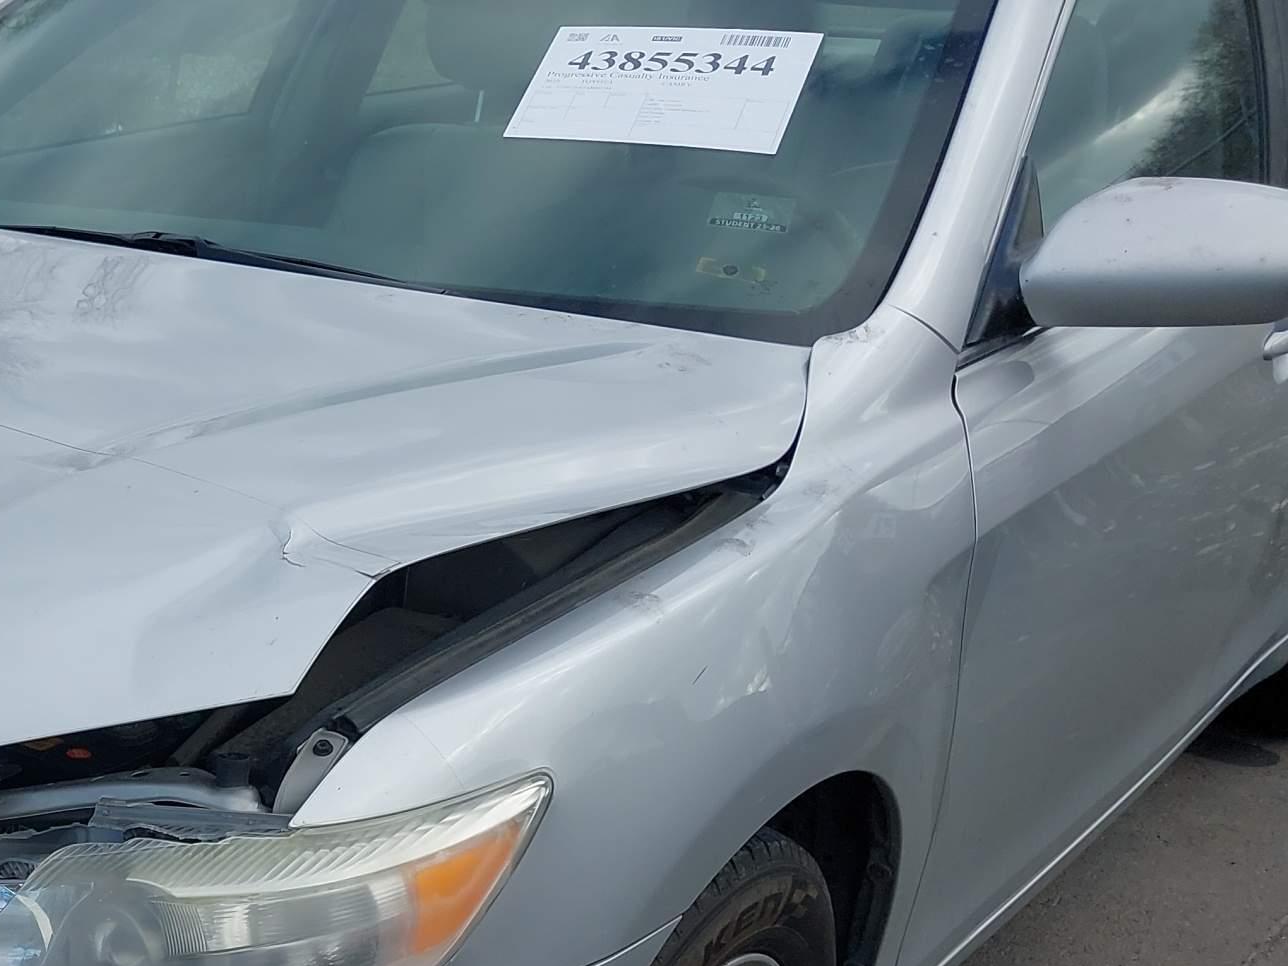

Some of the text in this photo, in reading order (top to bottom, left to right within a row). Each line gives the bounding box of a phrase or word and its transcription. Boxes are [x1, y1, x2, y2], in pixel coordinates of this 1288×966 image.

[568, 50, 777, 76] 43855344
[547, 71, 711, 82] Progressive Casualty Insurance
[715, 219, 755, 229] STUDENT
